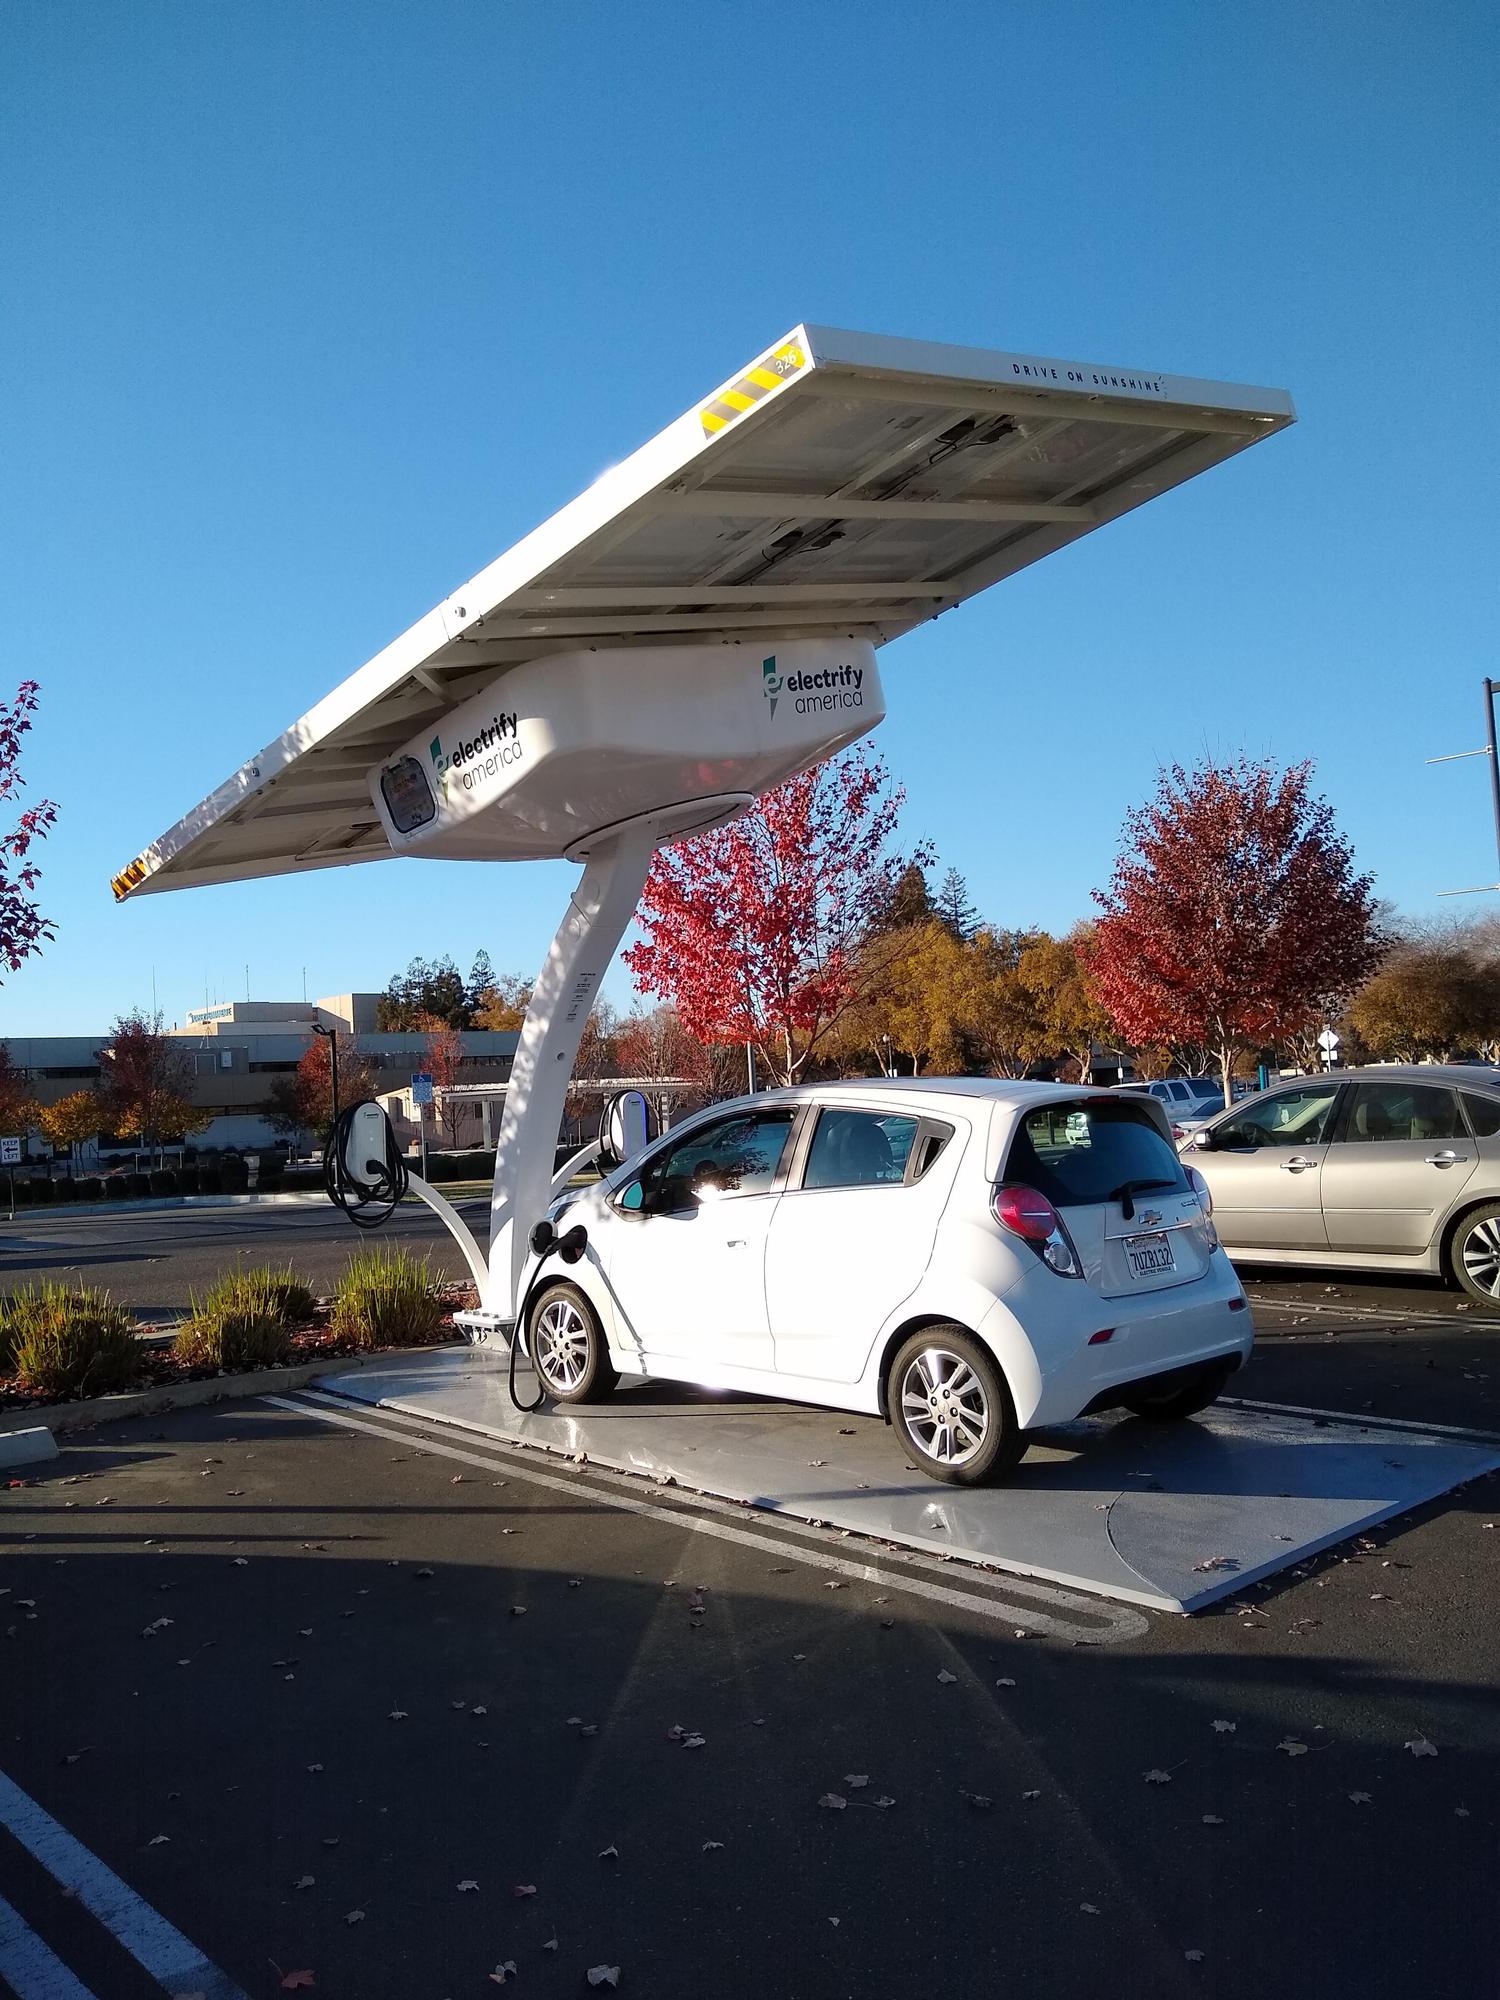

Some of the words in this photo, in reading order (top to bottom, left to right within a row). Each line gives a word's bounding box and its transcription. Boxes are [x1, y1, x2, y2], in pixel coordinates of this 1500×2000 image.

[775, 349, 797, 374] 326
[1012, 363, 1058, 379] DRIVE
[1067, 371, 1084, 383] ON
[1092, 374, 1160, 392] SUNSHINE
[787, 665, 863, 692] electrify
[795, 690, 863, 714] america
[452, 712, 518, 768] electrify
[462, 740, 523, 790] america
[1130, 1247, 1173, 1271] 7UZB132
